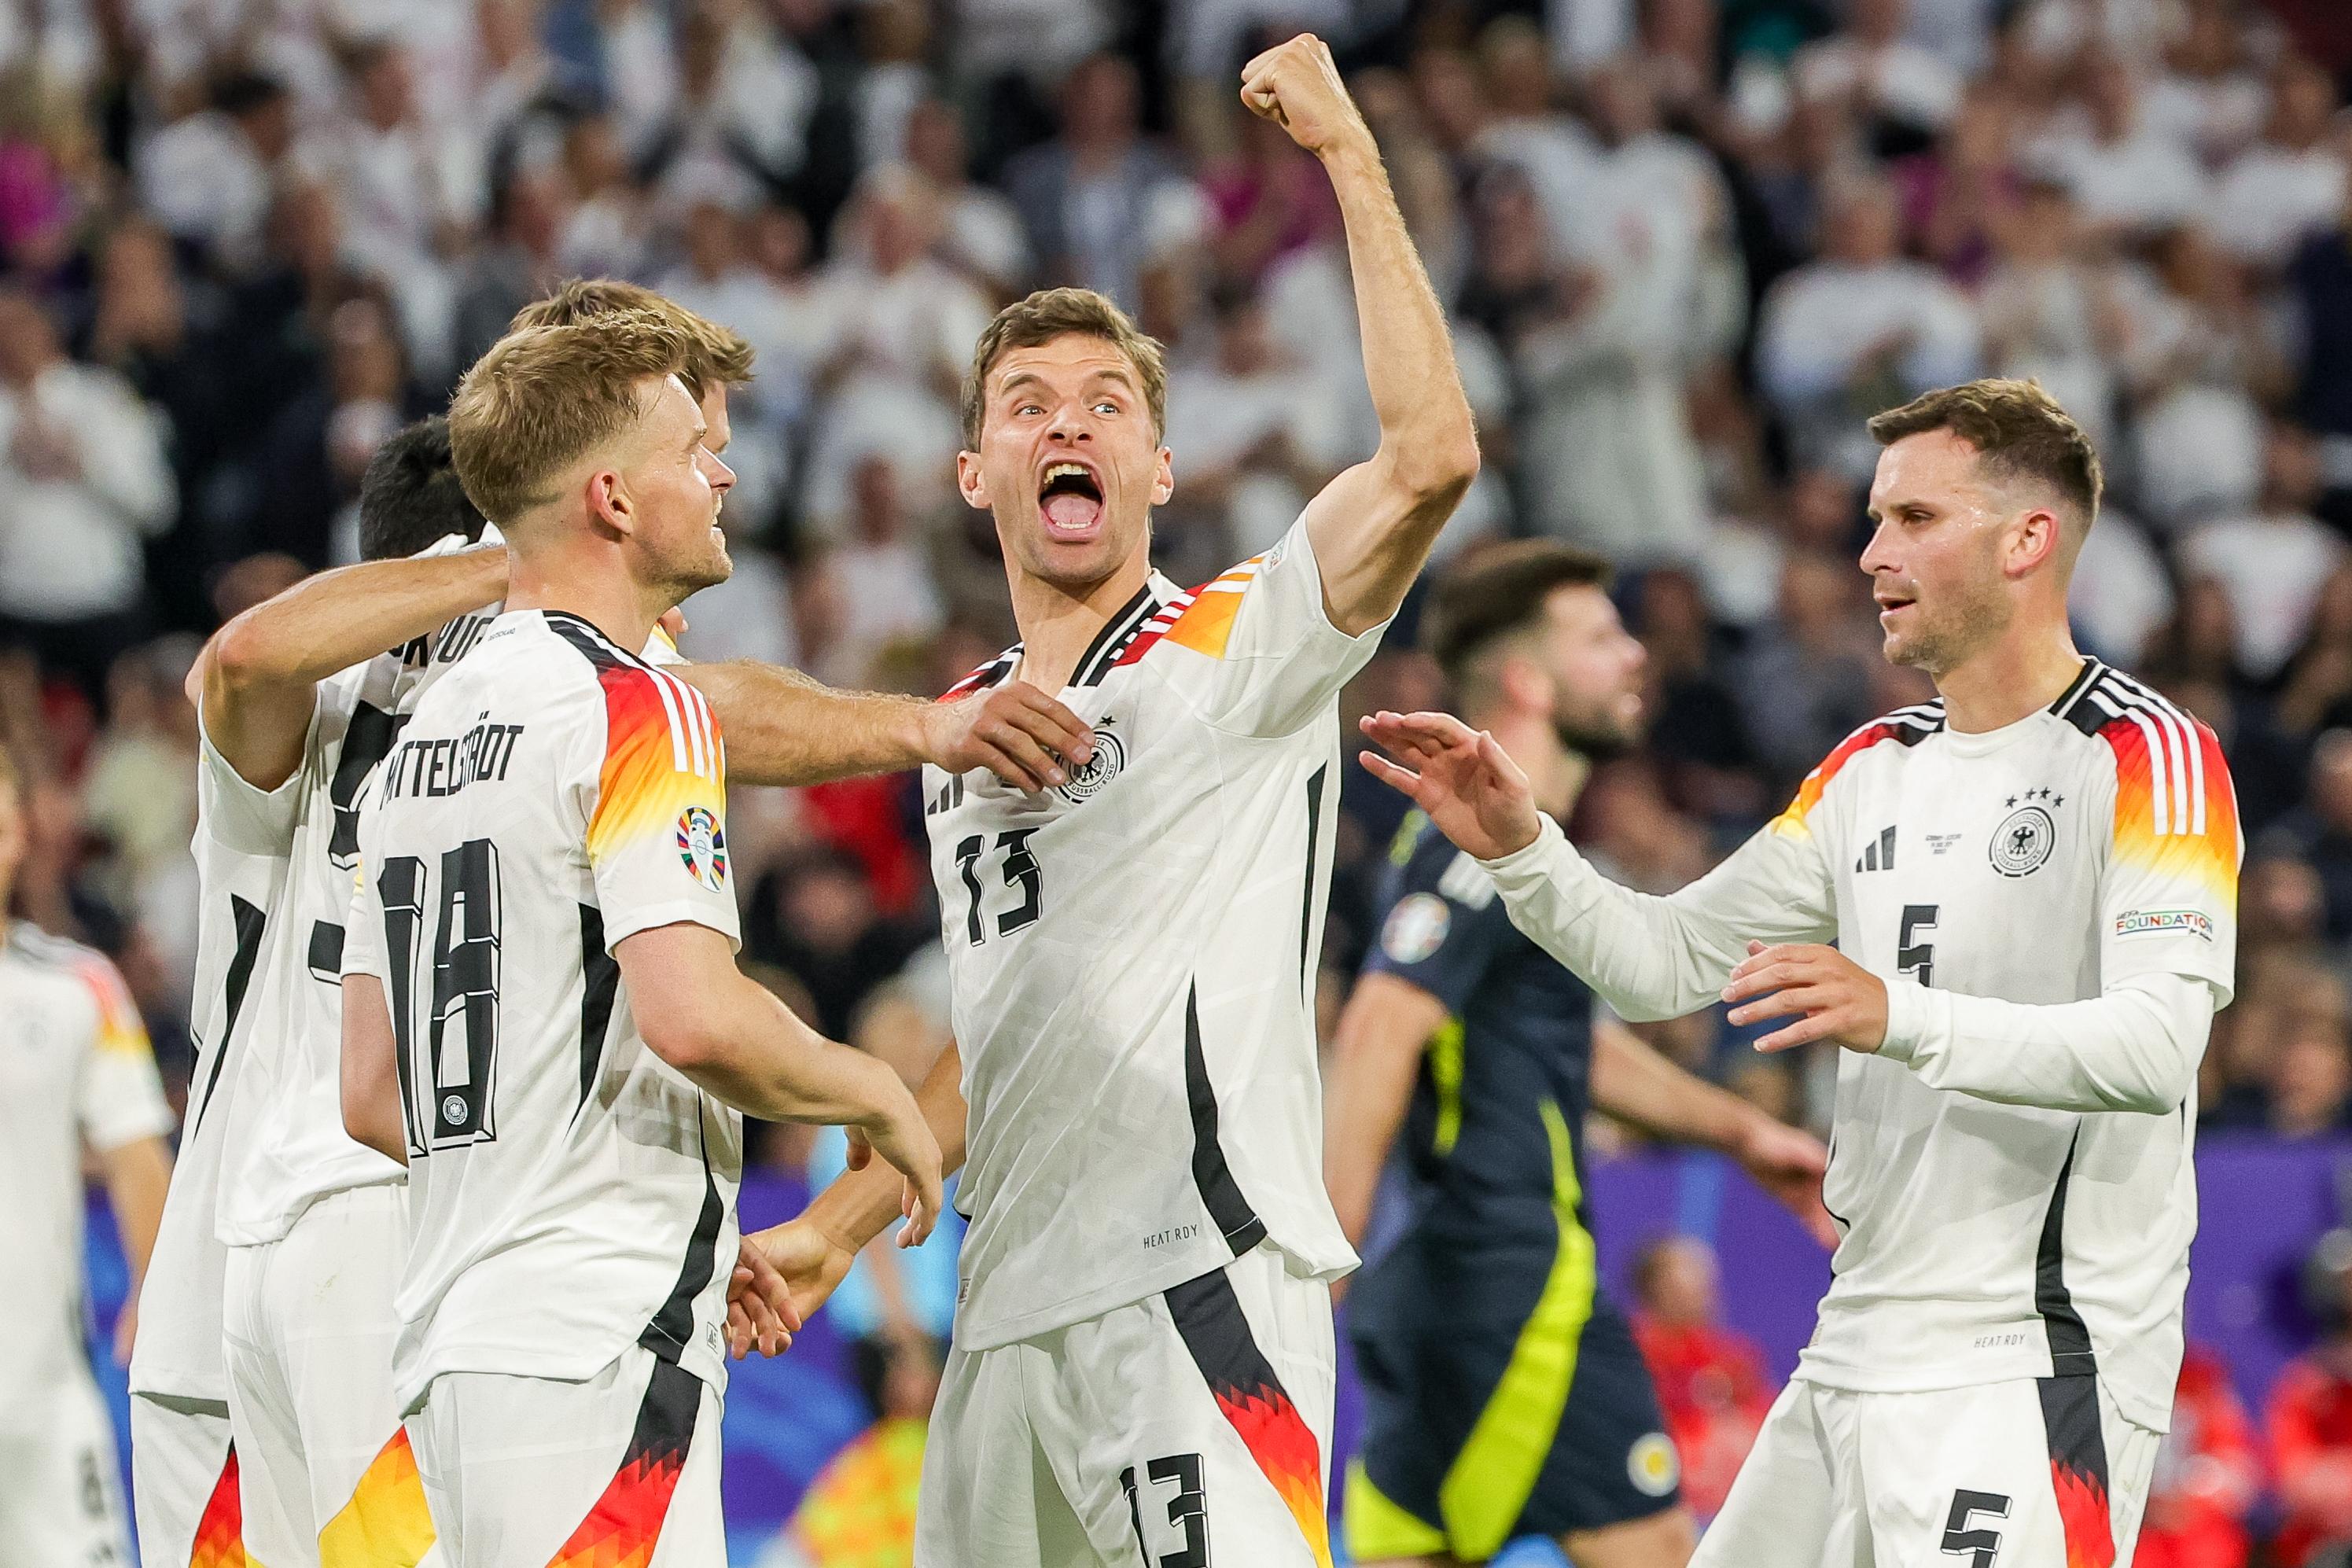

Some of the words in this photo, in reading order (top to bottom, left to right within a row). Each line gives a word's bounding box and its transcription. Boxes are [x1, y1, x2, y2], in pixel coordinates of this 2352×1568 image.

[955, 827, 1043, 947] 13
[2116, 914, 2213, 933] FOUNDATION
[1897, 904, 1940, 988] 5
[377, 838, 501, 1158] 18
[1119, 1453, 1212, 1568] 13
[1940, 1489, 2013, 1568] 5
